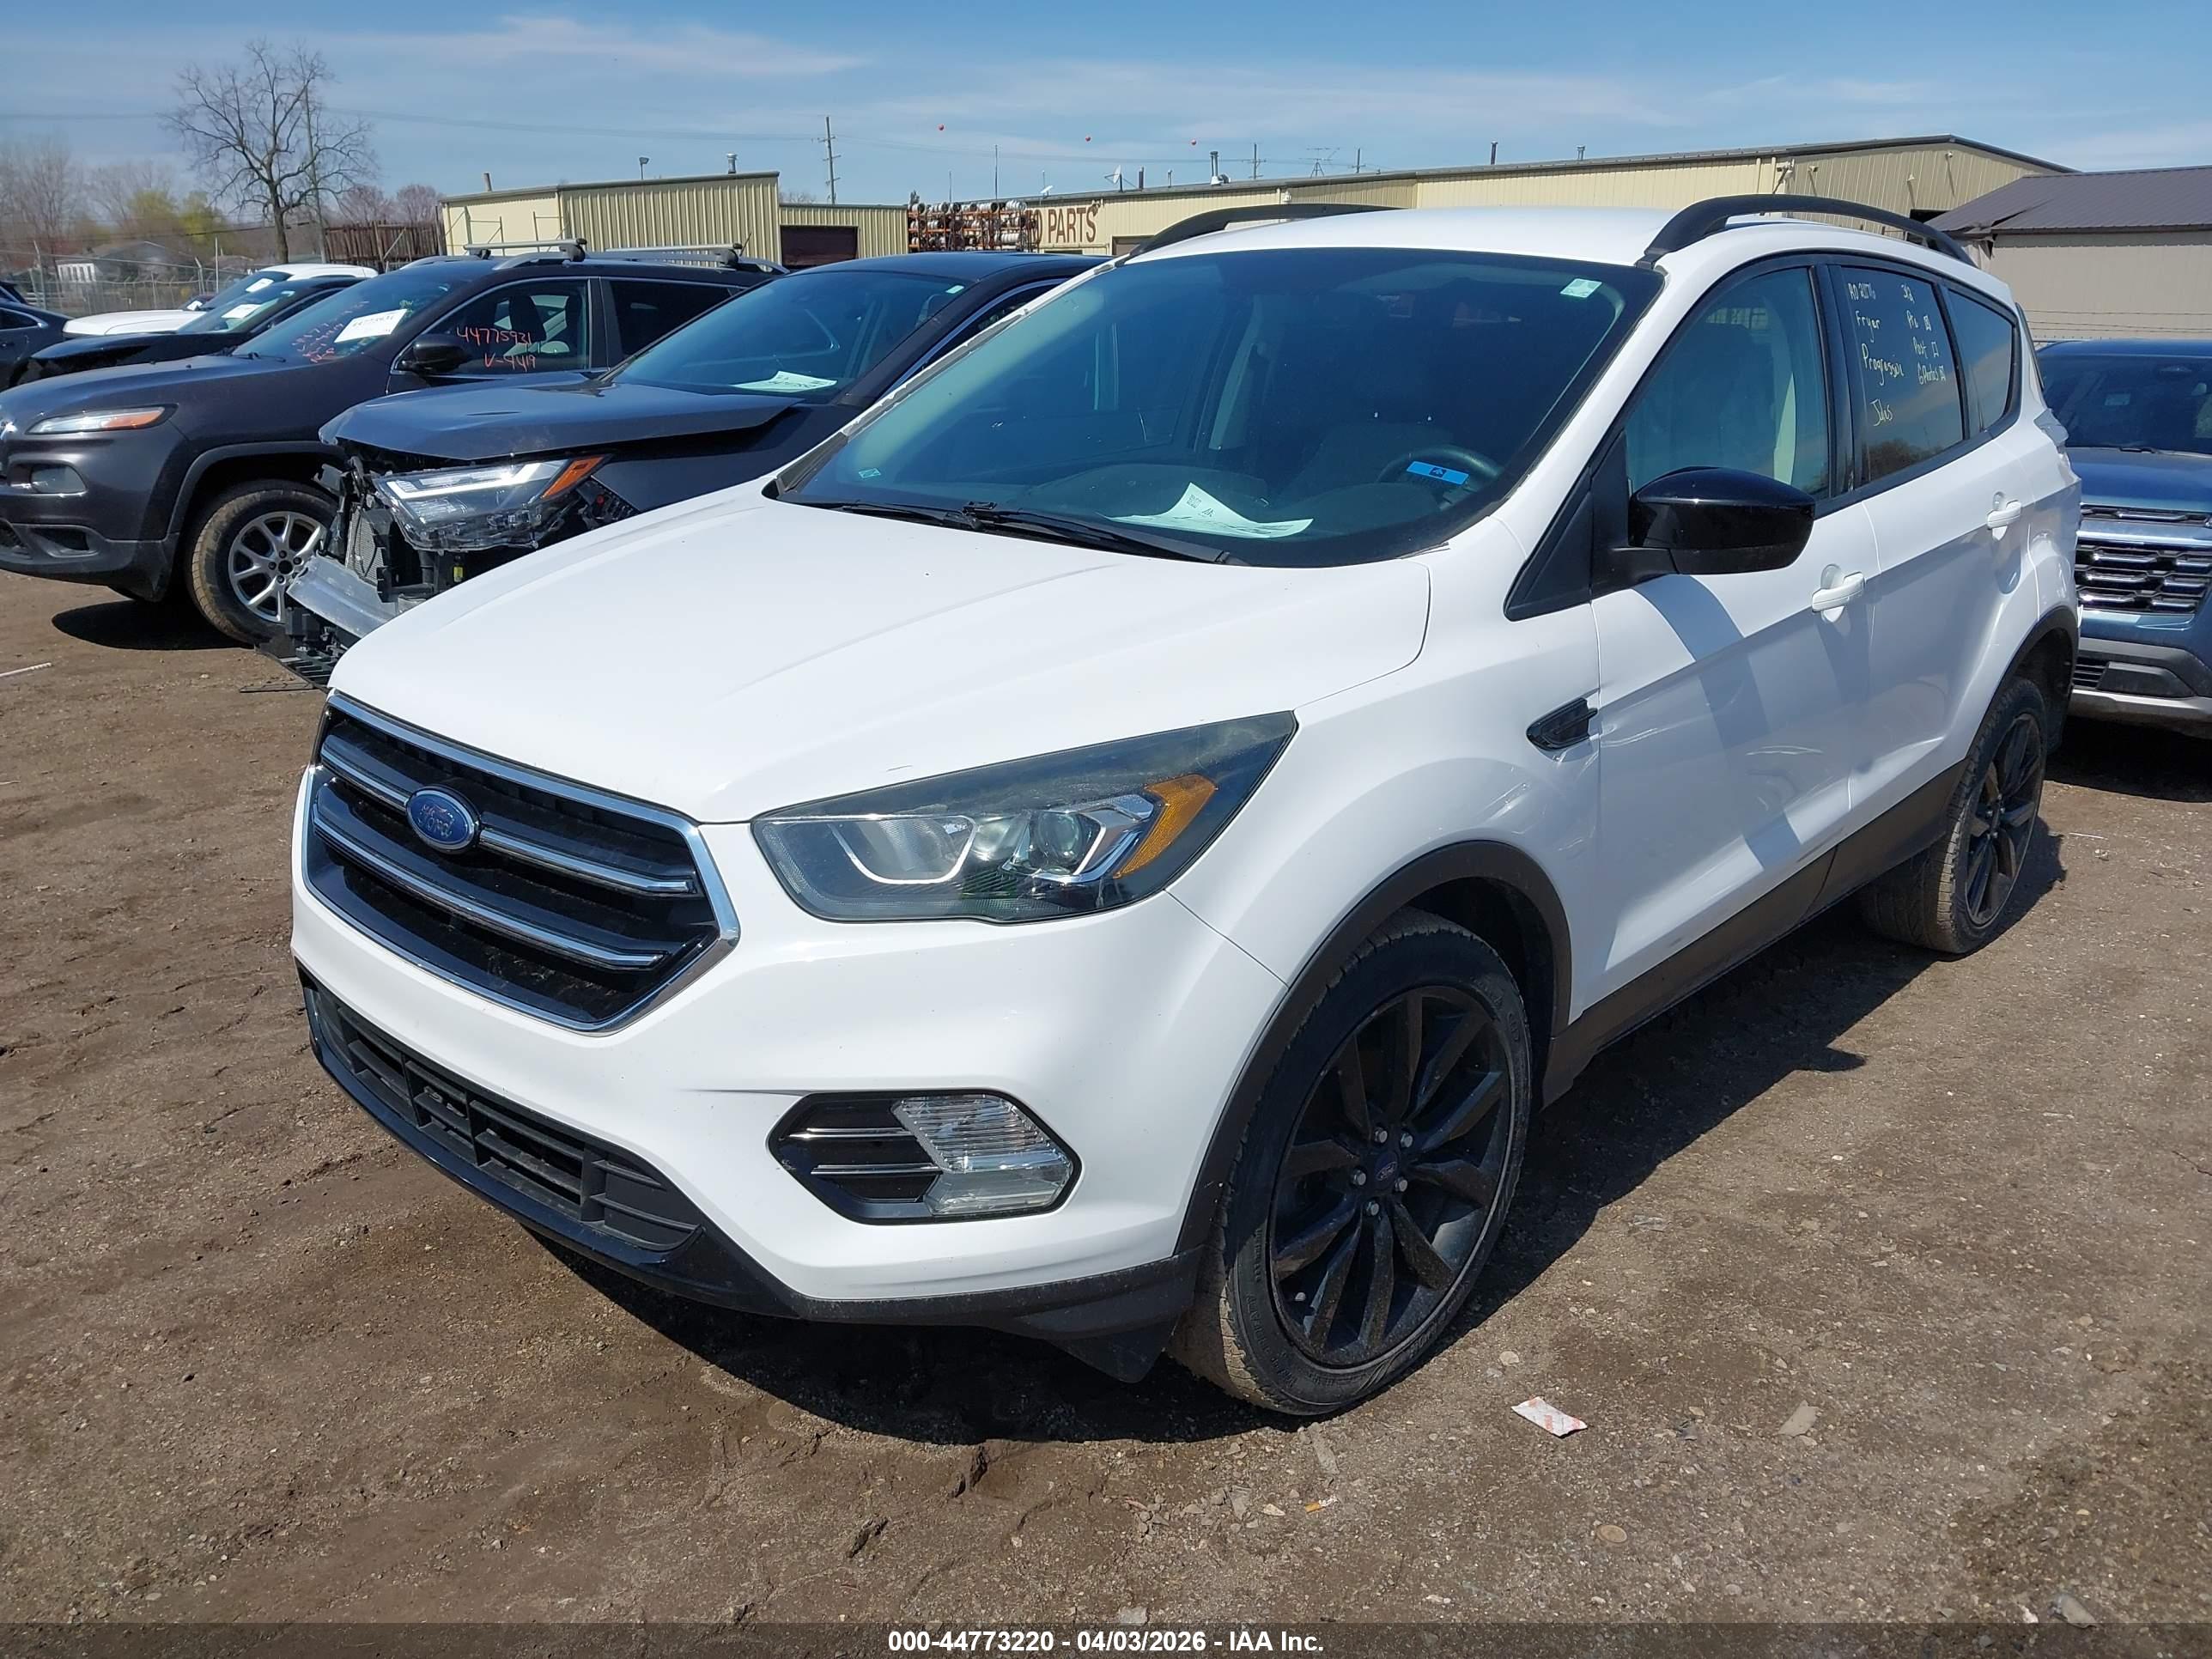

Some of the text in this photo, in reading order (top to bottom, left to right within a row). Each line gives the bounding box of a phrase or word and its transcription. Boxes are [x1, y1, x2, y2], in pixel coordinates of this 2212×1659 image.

[1048, 206, 1097, 243] PARTS
[456, 326, 532, 346] 44775931
[1855, 310, 1881, 343] Fryer
